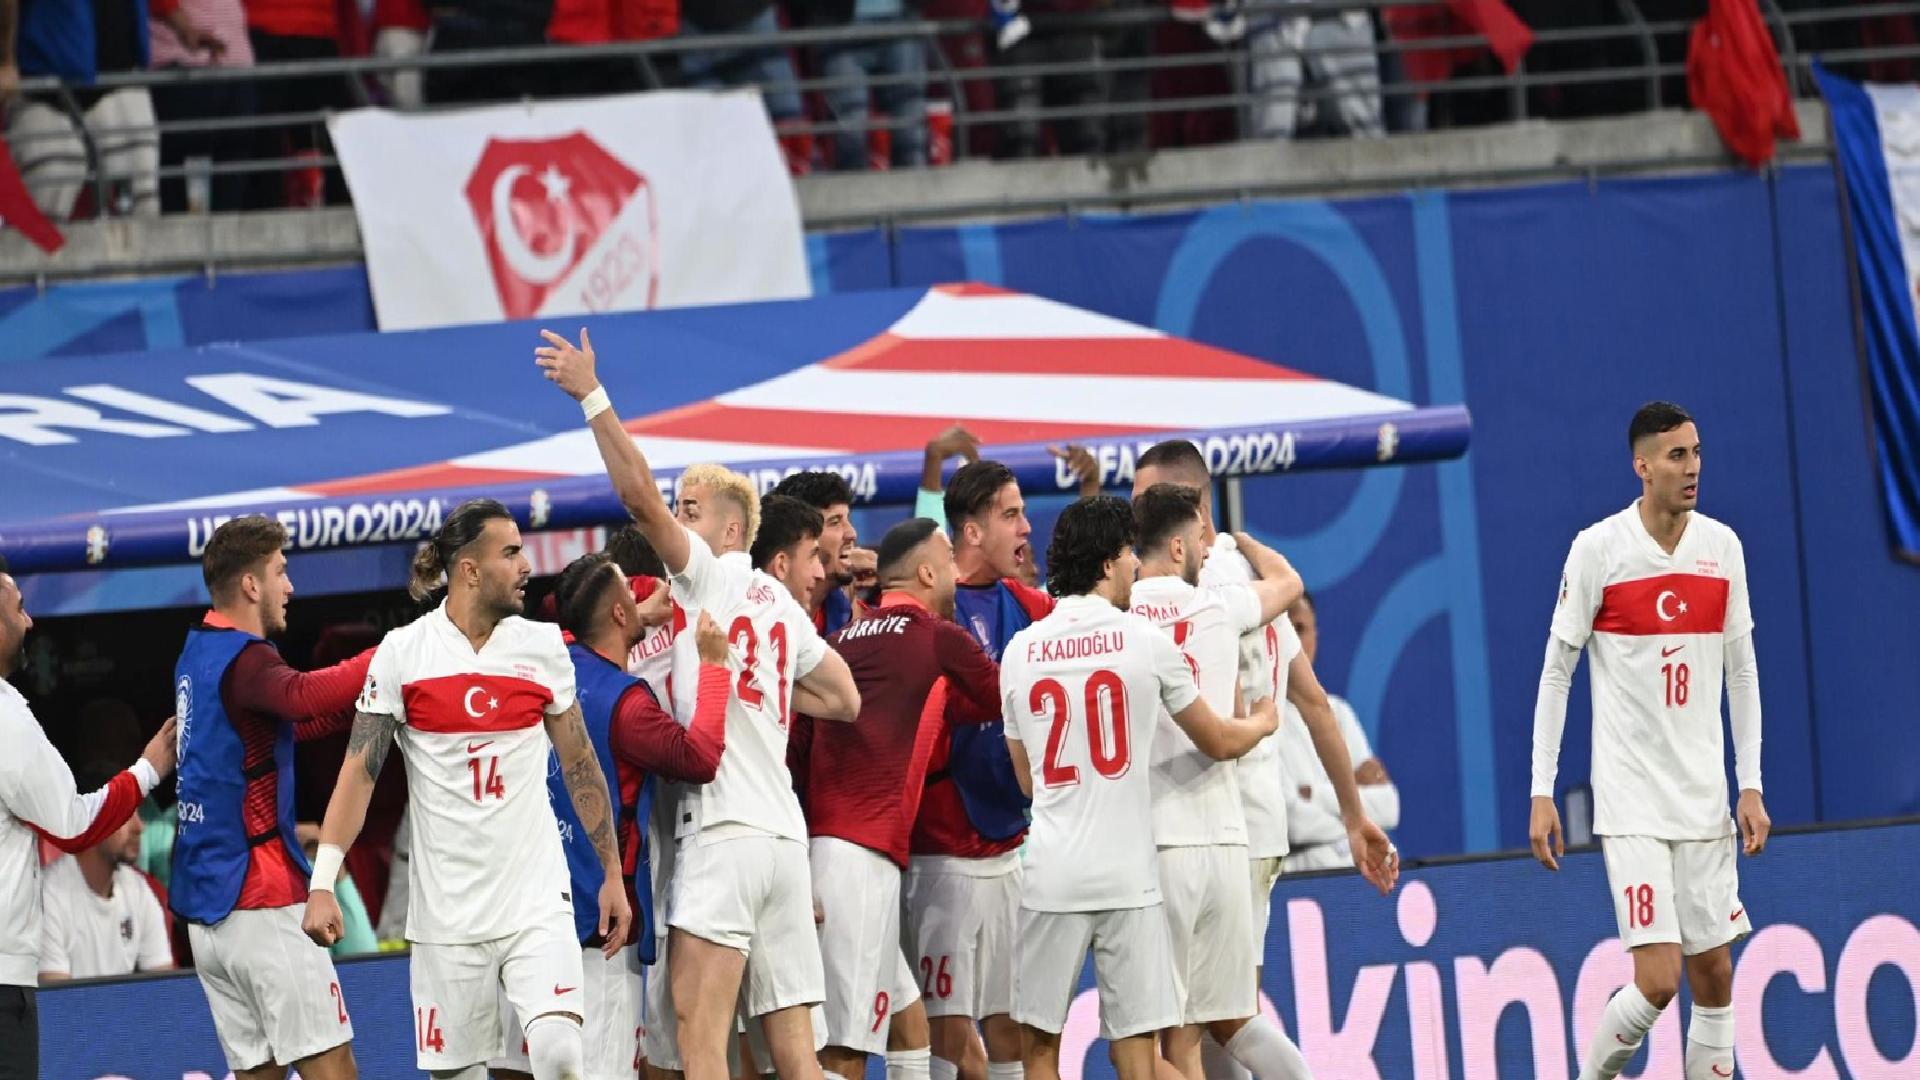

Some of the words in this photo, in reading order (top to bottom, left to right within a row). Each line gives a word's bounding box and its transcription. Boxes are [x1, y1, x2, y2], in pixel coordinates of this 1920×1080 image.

[581, 231, 644, 313] 1923
[838, 614, 910, 643] TÜRKİYE
[1027, 631, 1124, 663] F.KADIOĞLU
[728, 616, 789, 730] 21
[1661, 662, 1688, 706] 18
[1029, 669, 1131, 789] 20
[467, 756, 505, 802] 14
[1624, 883, 1654, 929] 18
[920, 955, 953, 998] 26
[418, 1006, 445, 1053] 14
[872, 991, 889, 1032] 9
